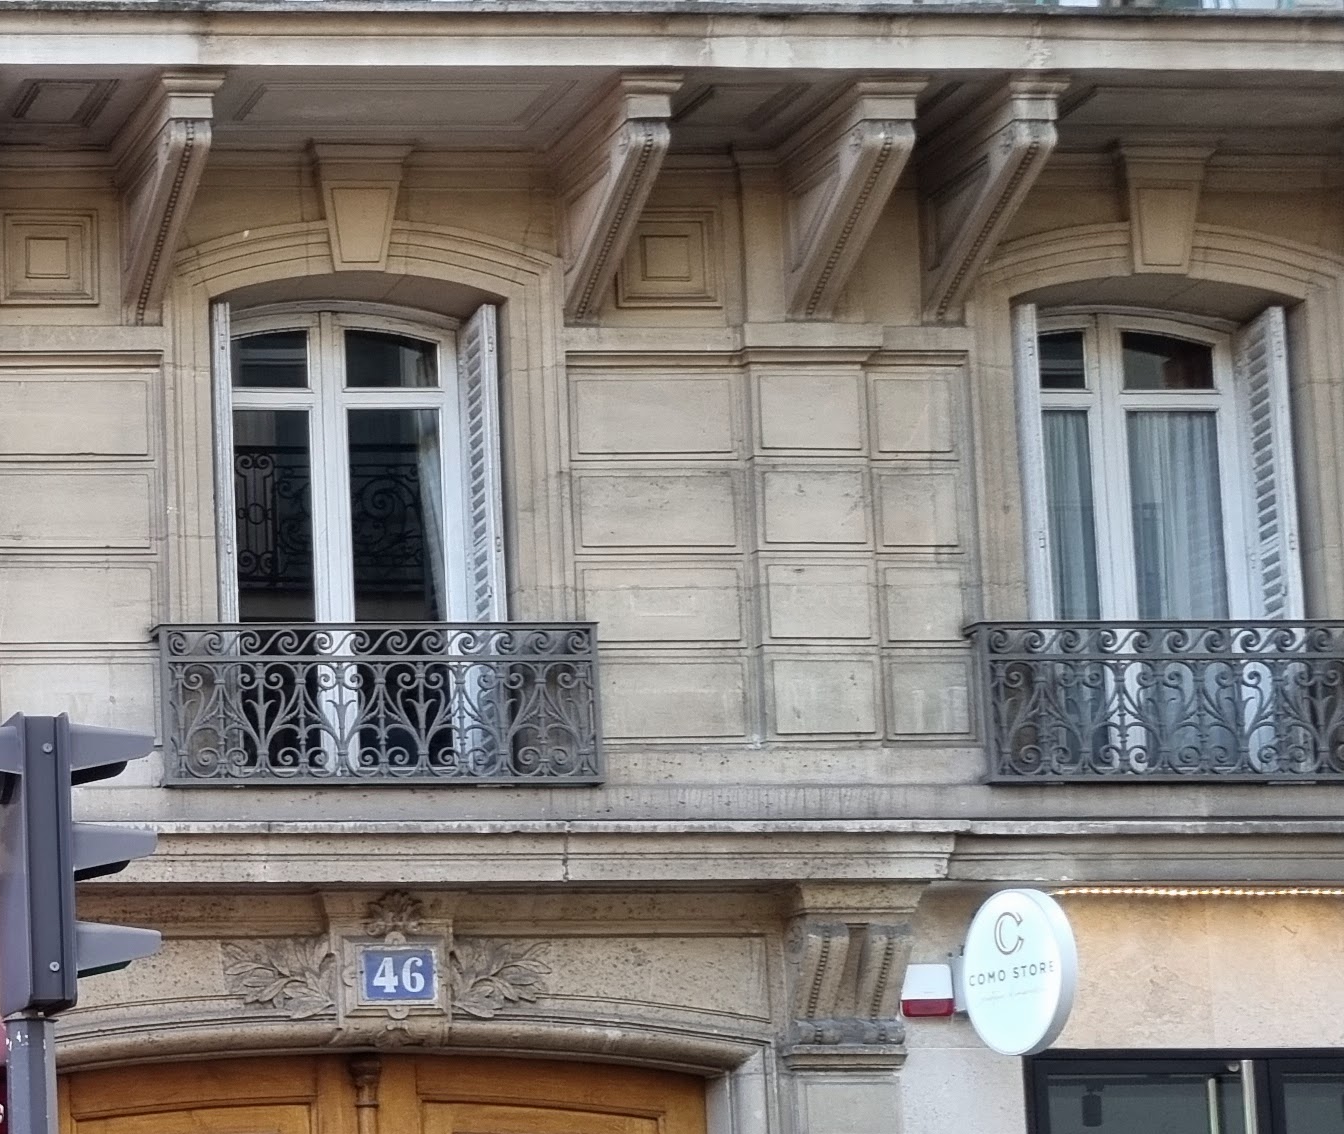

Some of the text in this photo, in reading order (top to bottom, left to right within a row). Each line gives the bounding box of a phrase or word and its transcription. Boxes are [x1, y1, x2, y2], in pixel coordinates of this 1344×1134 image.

[993, 911, 1024, 956] C
[372, 956, 425, 993] 46
[968, 960, 1055, 987] COMO STORE
